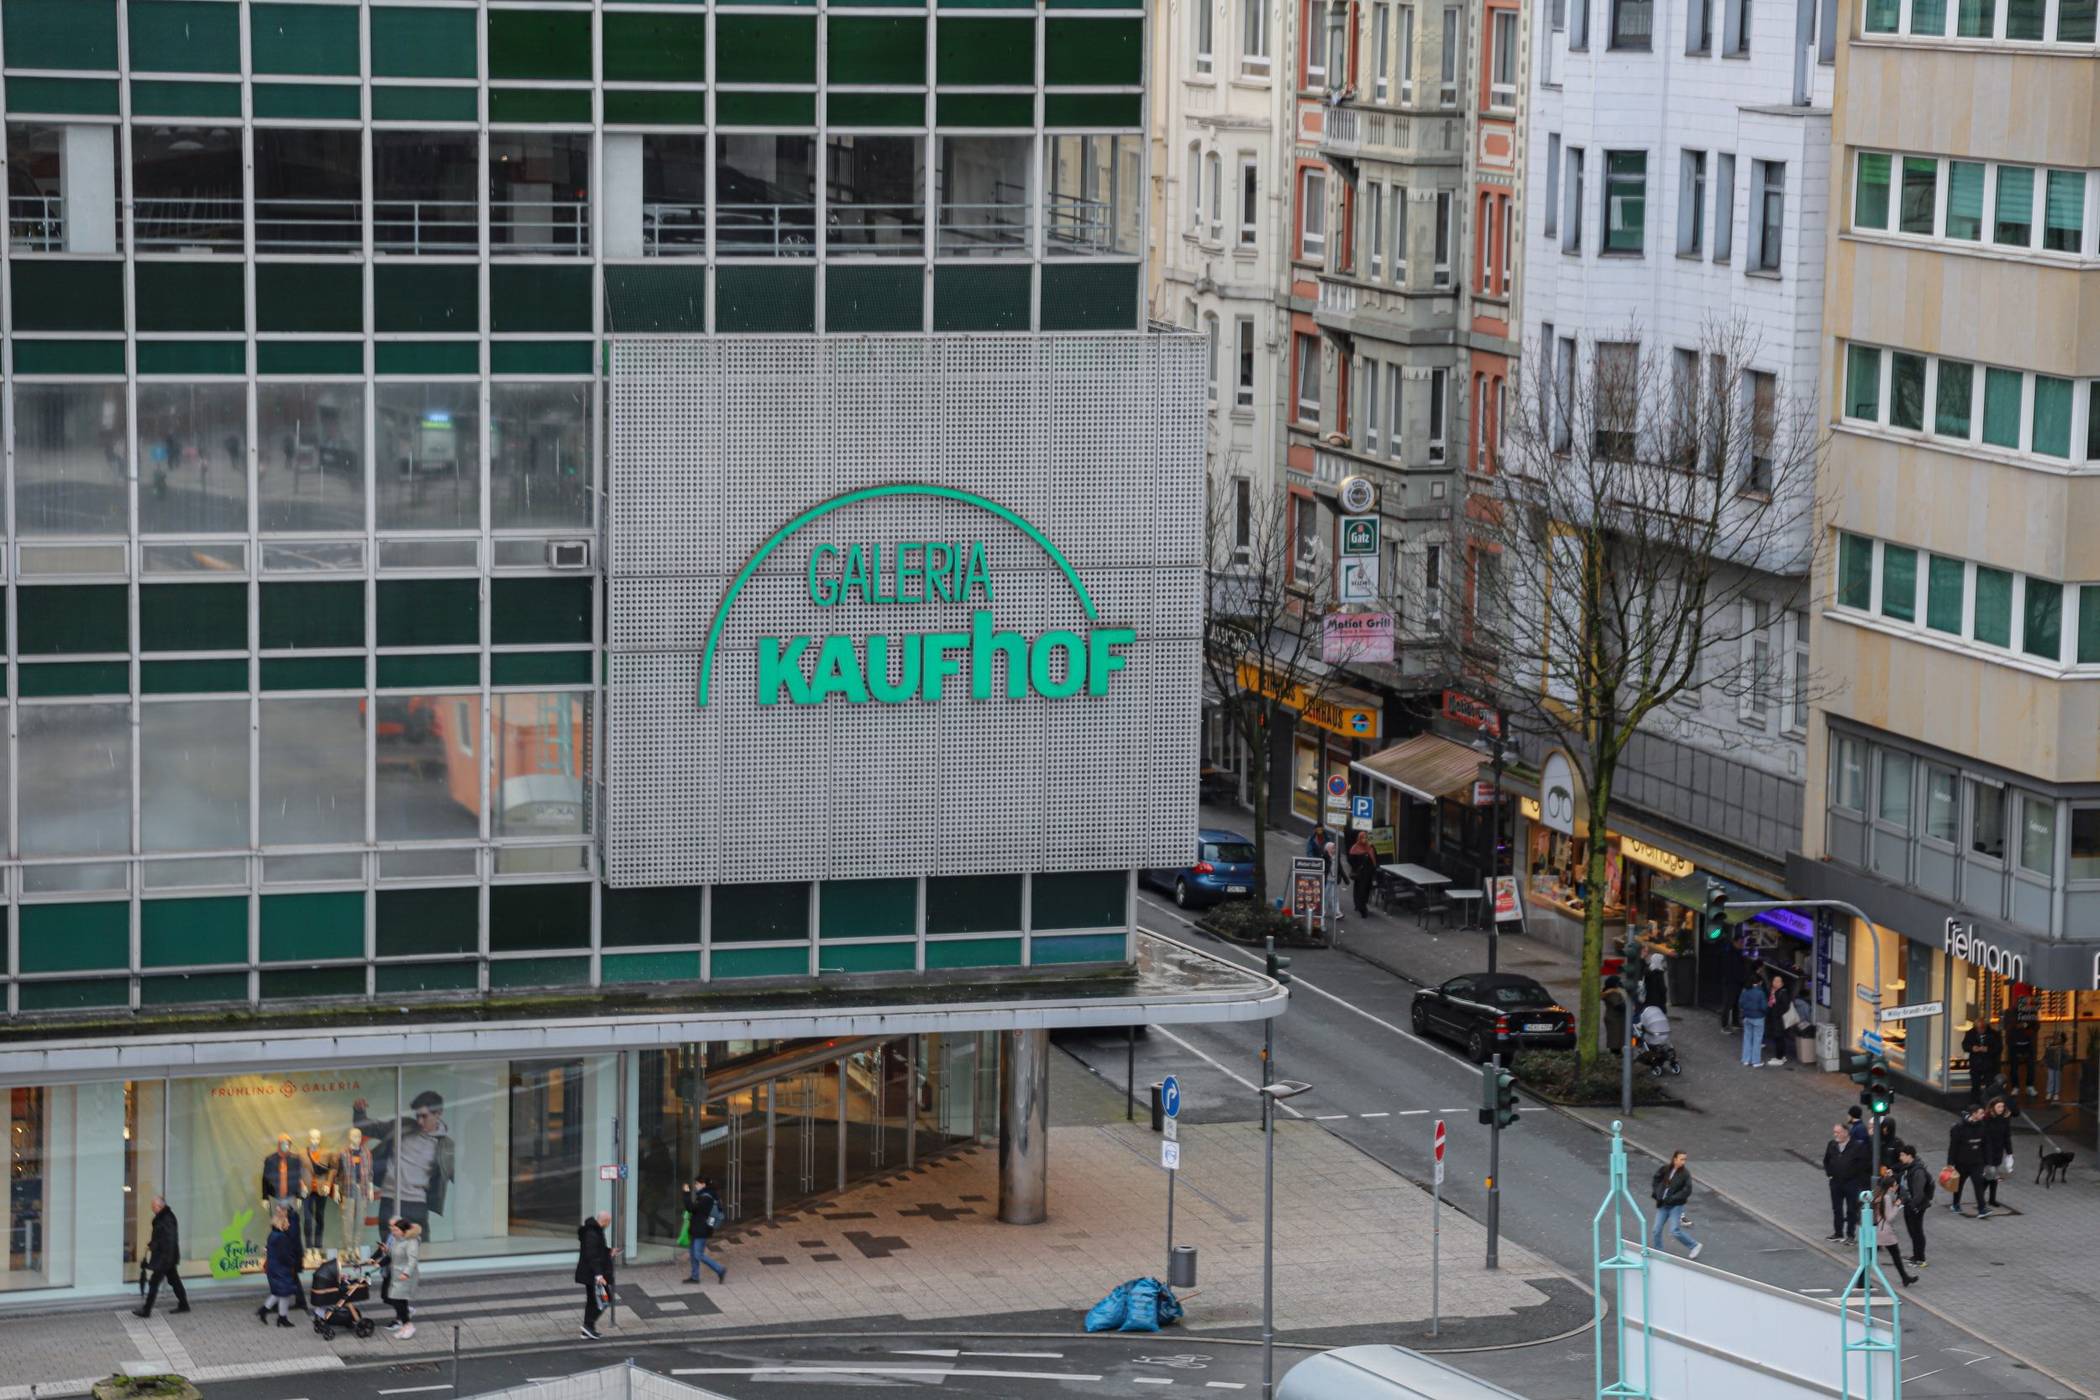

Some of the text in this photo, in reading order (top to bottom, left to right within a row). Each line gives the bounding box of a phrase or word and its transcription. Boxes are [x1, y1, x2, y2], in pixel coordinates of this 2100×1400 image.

[807, 541, 994, 607] GALERIA
[1367, 617, 1391, 629] Grill
[1357, 799, 1369, 815] P
[303, 1081, 360, 1093] GALERIA
